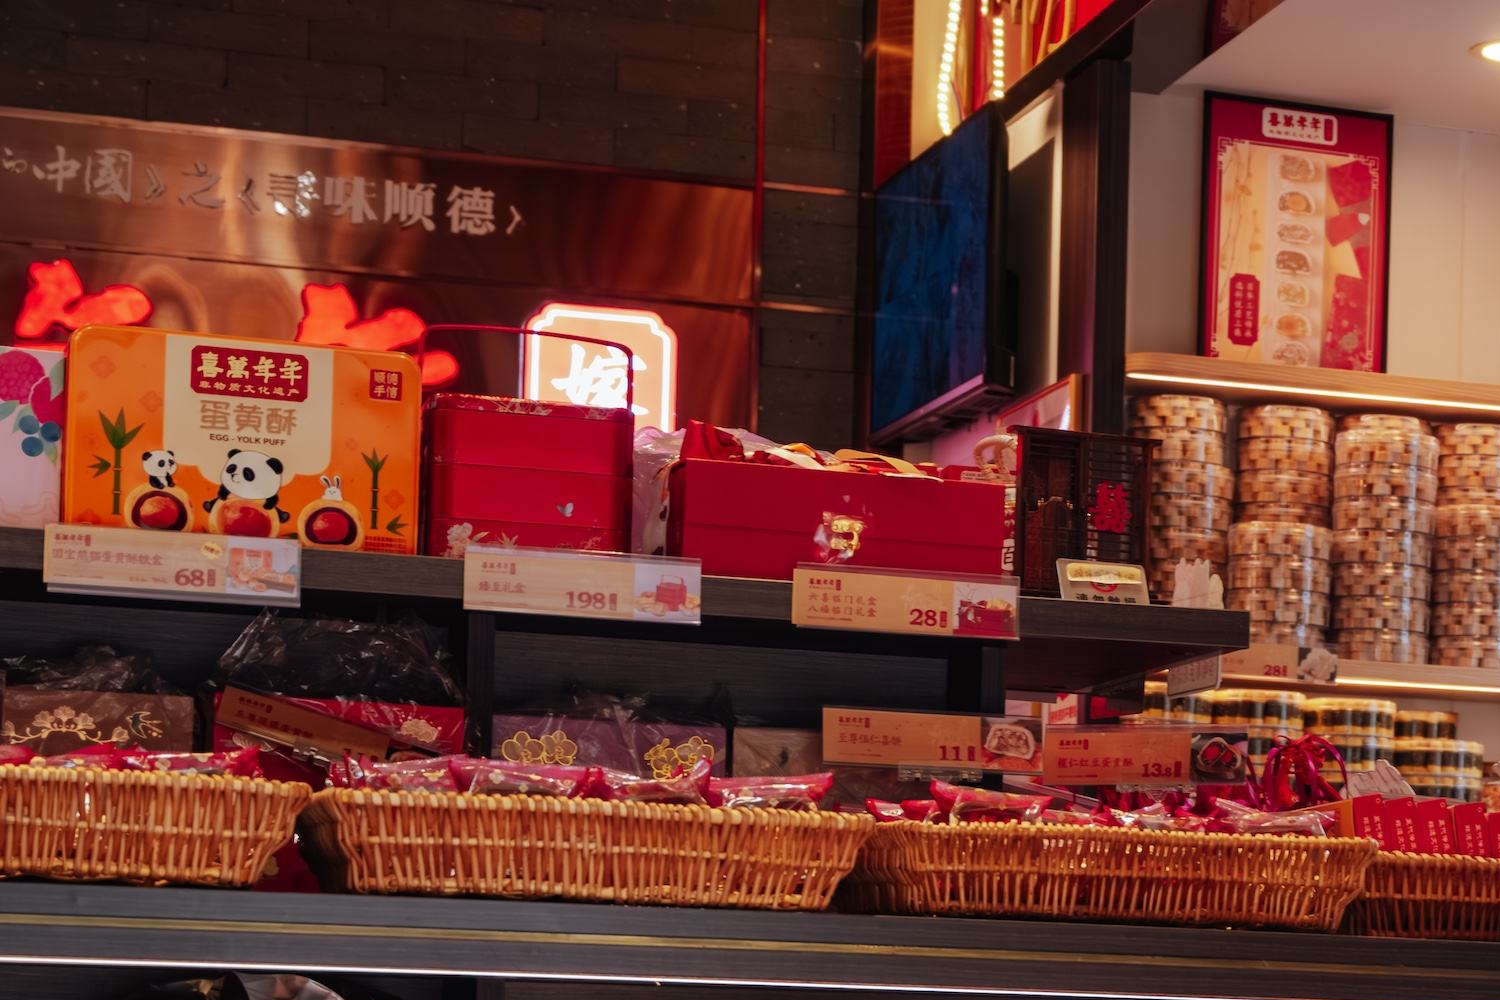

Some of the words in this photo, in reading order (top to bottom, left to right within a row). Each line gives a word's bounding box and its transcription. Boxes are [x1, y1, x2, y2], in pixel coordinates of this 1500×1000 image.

[197, 351, 303, 387] 喜萬年年
[199, 400, 298, 436] 蛋黄酥
[209, 433, 230, 443] EGG
[237, 435, 261, 445] YOLK
[263, 438, 286, 447] PUFF
[174, 568, 204, 587] 68
[565, 591, 606, 610] 198
[910, 608, 937, 627] 28
[1264, 664, 1281, 677] 28
[939, 745, 962, 762] 11
[1142, 763, 1172, 778] 13.8
